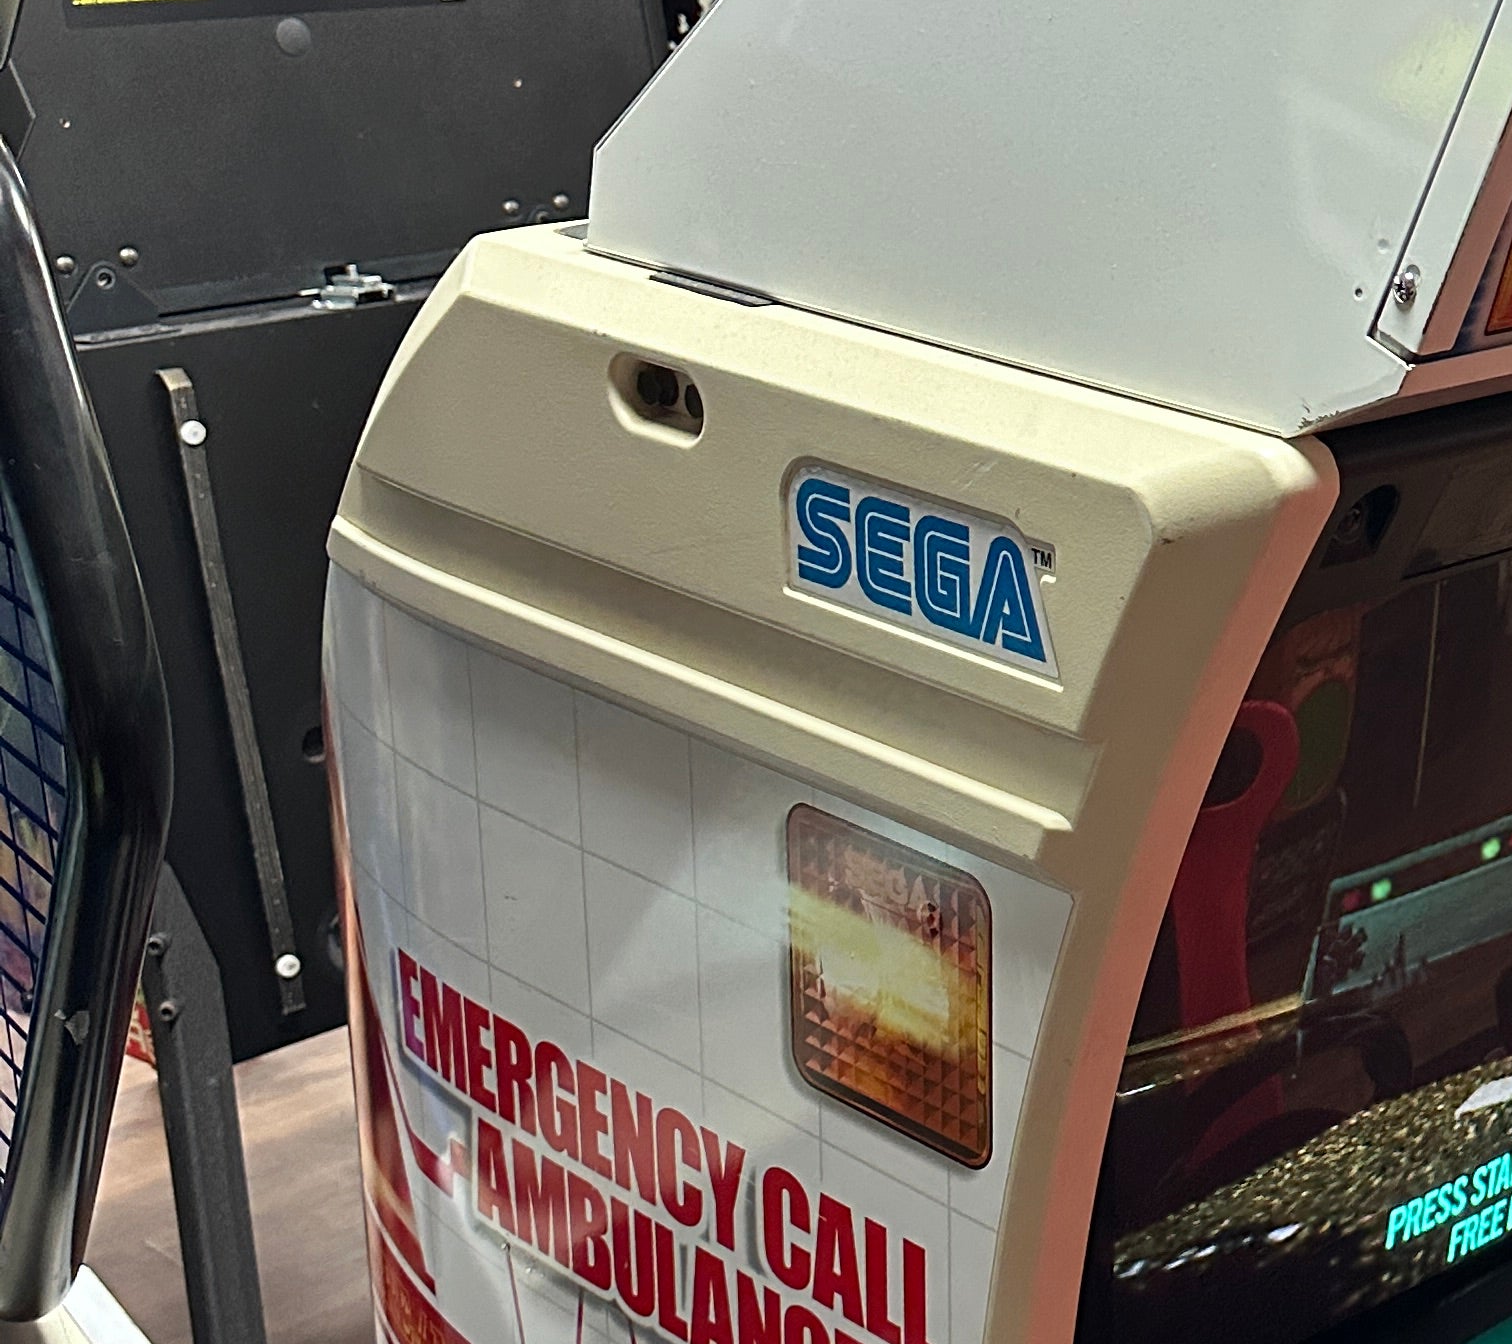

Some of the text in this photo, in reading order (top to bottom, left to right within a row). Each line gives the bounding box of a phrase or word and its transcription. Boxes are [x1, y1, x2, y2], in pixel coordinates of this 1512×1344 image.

[796, 477, 1048, 664] SEGA
[398, 946, 746, 1251] EMERGENCY
[1385, 1174, 1469, 1250] PRESS
[1447, 1198, 1508, 1263] FREE
